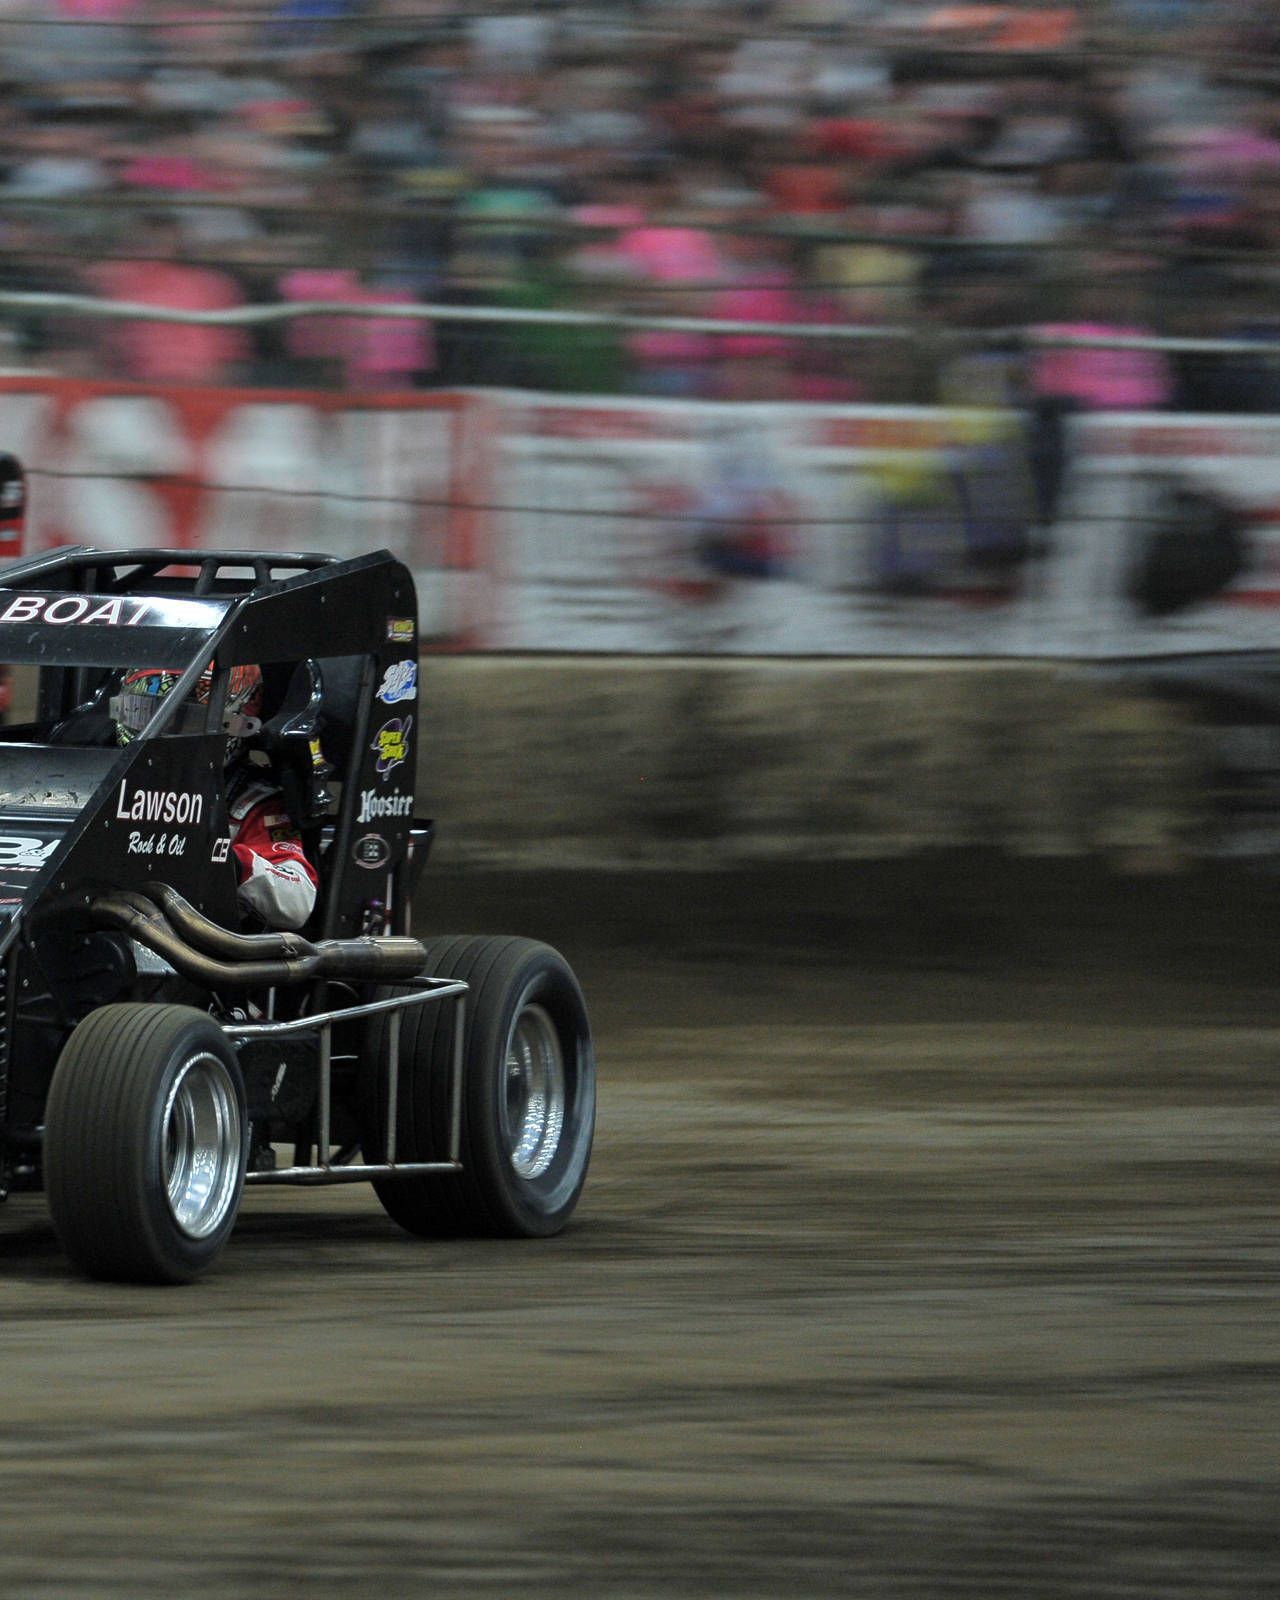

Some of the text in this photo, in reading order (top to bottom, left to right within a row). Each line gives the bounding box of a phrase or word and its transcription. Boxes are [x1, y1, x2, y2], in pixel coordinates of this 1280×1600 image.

[0, 595, 156, 626] BOAT
[116, 778, 204, 824] Lawson
[356, 786, 414, 823] Hoosier
[127, 831, 187, 856] Rock & Oil
